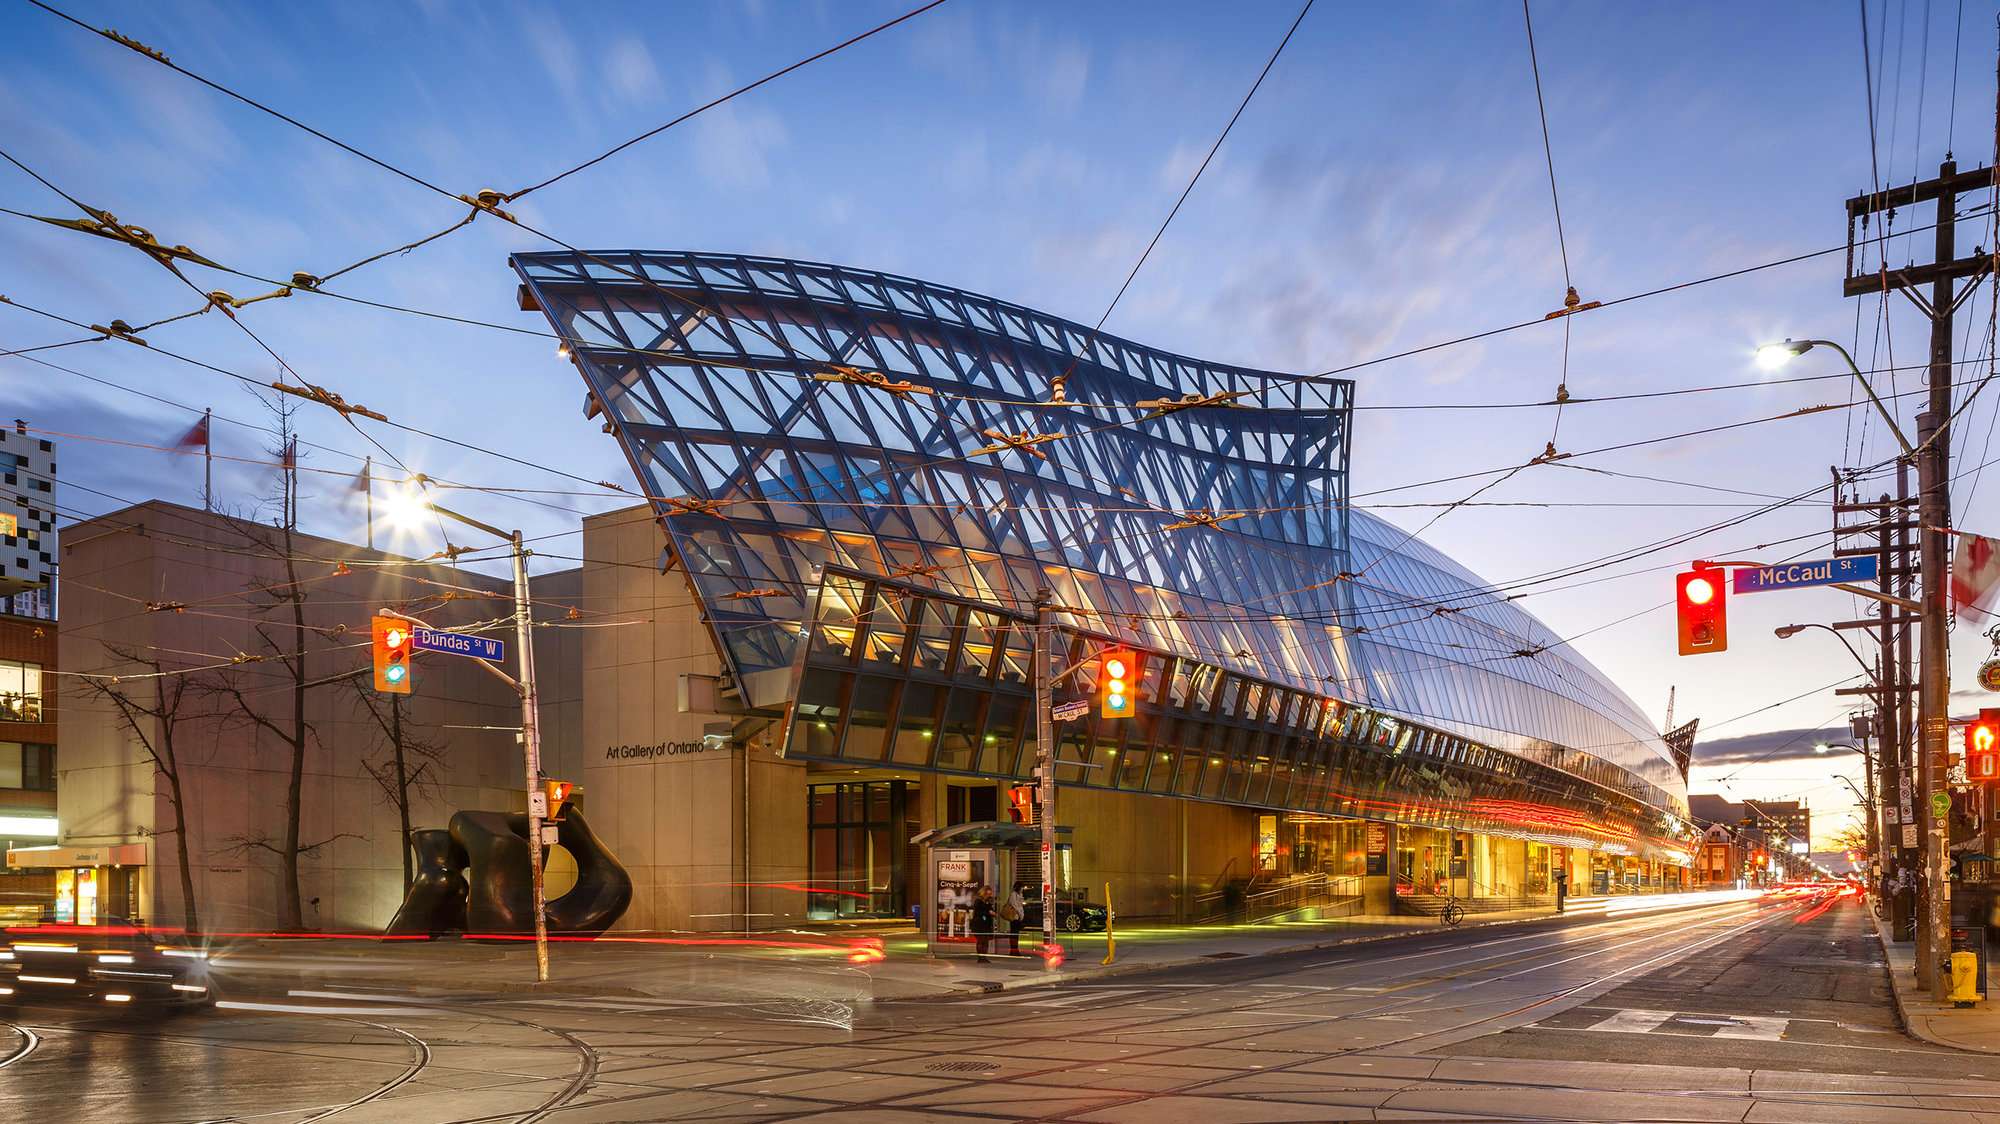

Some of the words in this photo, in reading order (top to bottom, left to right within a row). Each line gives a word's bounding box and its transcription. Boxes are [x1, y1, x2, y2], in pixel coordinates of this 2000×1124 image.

[1759, 560, 1832, 585] McCaul
[1840, 560, 1851, 570] St
[422, 630, 470, 651] Dundas
[474, 639, 481, 647] St
[486, 641, 496, 655] W
[606, 746, 619, 759] Art
[620, 745, 655, 759] Gallery
[656, 742, 666, 756] of
[667, 740, 704, 755] Ontario
[940, 863, 967, 871] FRANK
